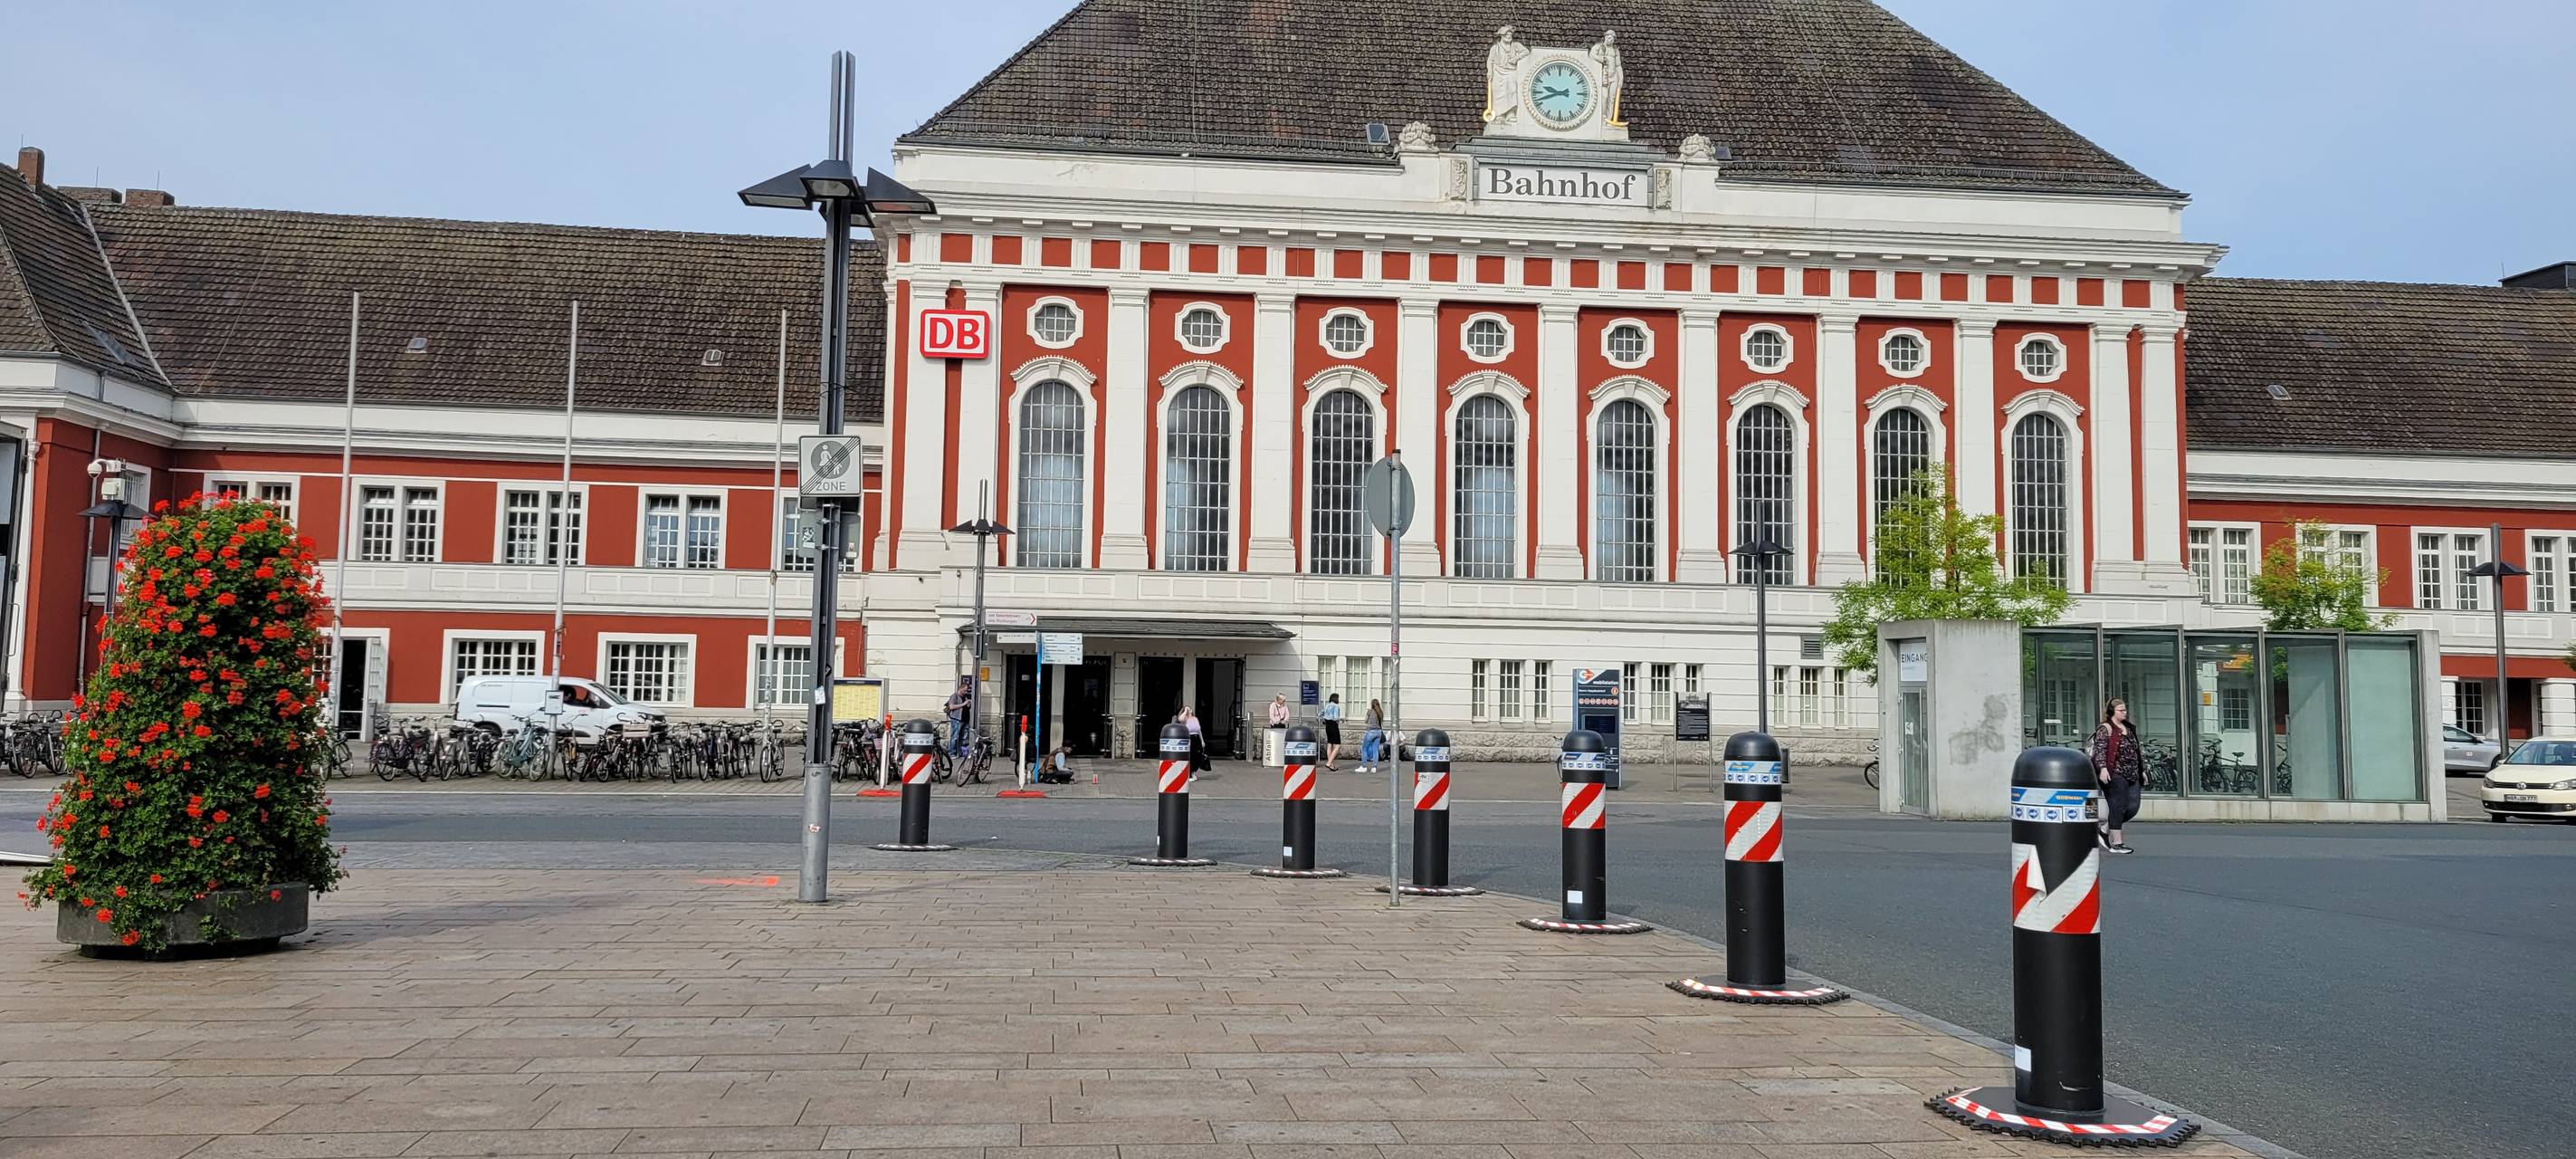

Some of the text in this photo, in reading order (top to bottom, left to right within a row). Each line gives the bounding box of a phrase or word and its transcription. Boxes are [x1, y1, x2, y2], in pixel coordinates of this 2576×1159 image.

[1487, 168, 1636, 200] Bahnhof
[929, 317, 980, 350] DB
[816, 481, 846, 492] ZONE
